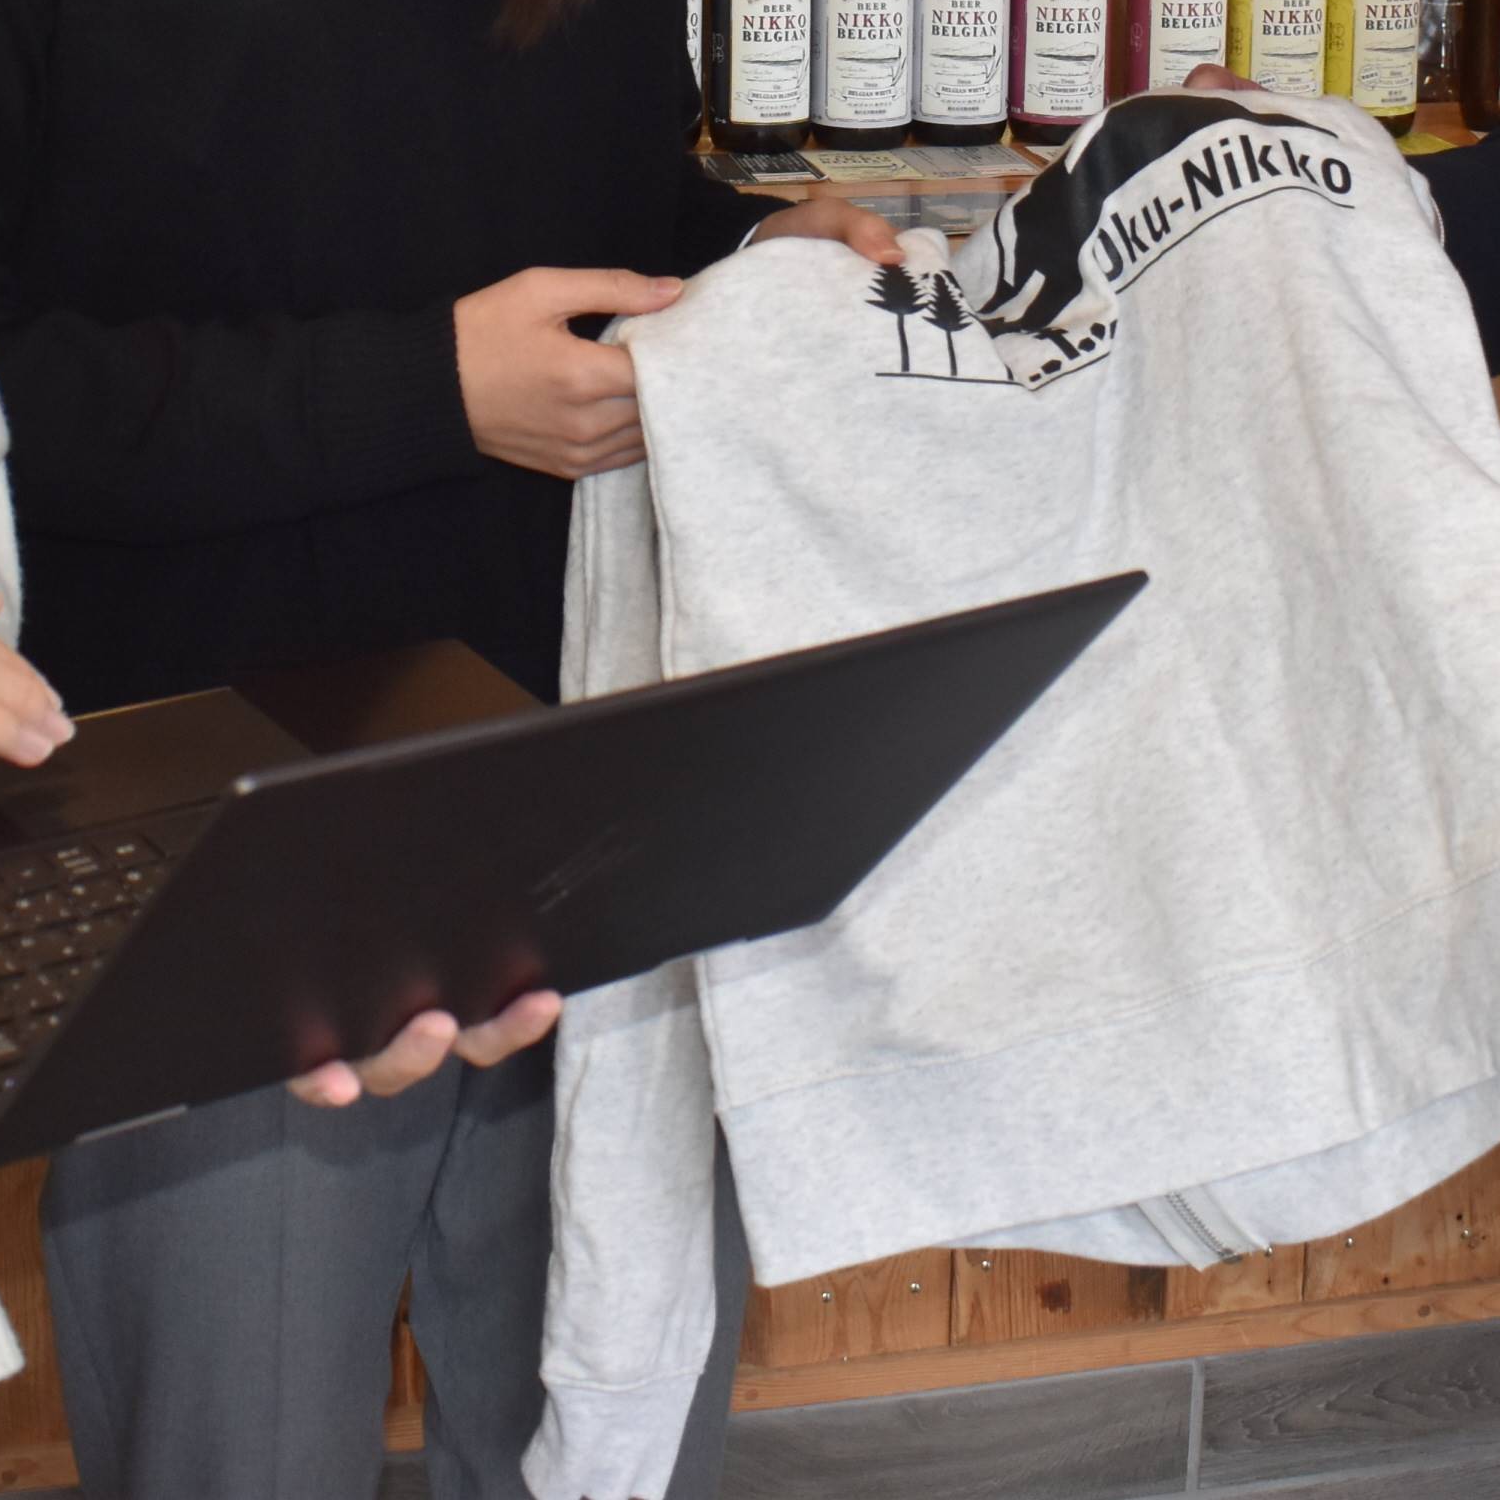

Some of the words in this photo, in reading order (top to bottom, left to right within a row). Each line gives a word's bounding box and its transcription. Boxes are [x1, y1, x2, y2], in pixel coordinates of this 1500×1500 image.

[763, 3, 792, 13] BEER
[857, 2, 887, 11] BEER
[951, 0, 981, 9] BEER
[1161, 1, 1223, 17] NIKKO
[1366, 2, 1419, 18] NIKKO
[837, 11, 903, 28] NIKKO
[931, 10, 998, 25] NIKKO
[1037, 6, 1102, 22] NIKKO
[1262, 8, 1323, 24] NIKKO
[742, 13, 807, 30] NIKKO
[1036, 21, 1101, 35] BELGIAN
[1161, 16, 1223, 29] BELGIAN
[742, 29, 806, 43] BELGIAN
[837, 27, 903, 40] BELGIAN
[931, 24, 997, 38] BELGIAN
[1262, 23, 1322, 37] BELGIAN
